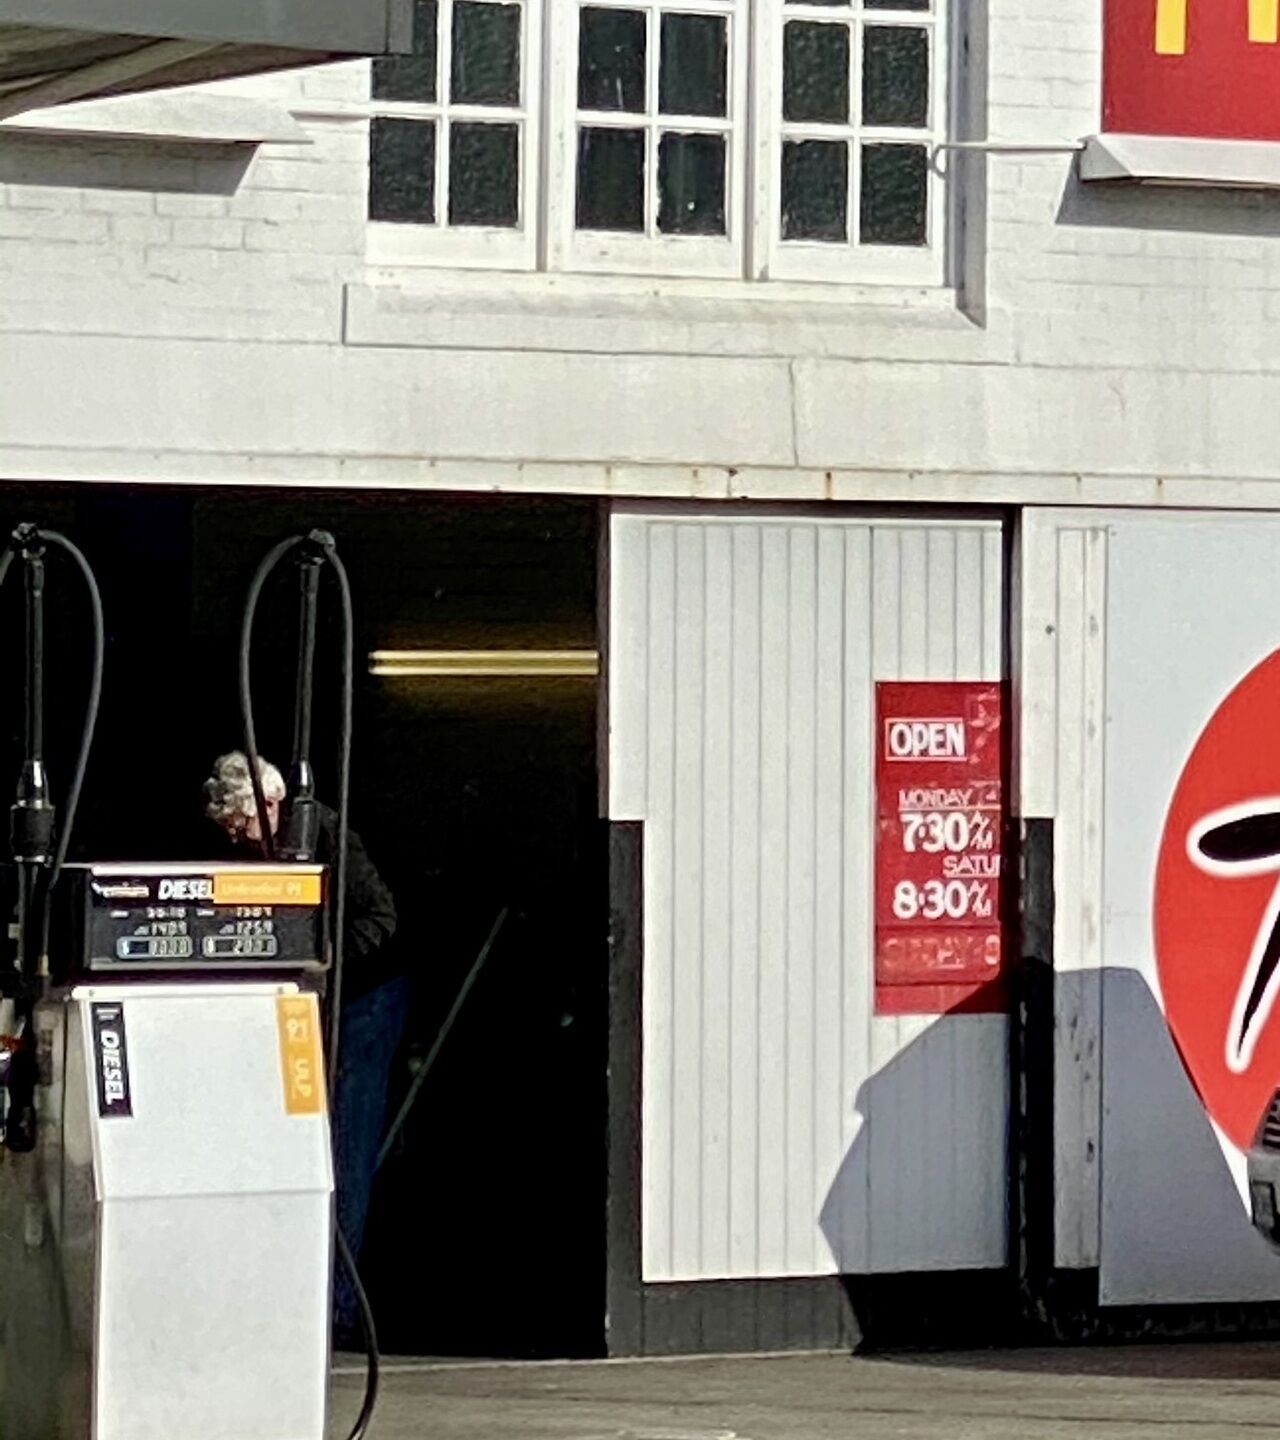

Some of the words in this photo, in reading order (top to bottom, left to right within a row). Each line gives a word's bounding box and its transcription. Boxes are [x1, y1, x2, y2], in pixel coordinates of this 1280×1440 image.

[890, 722, 965, 757] OPEN
[158, 878, 214, 900] DIESEL
[100, 1031, 124, 1105] DIESEL
